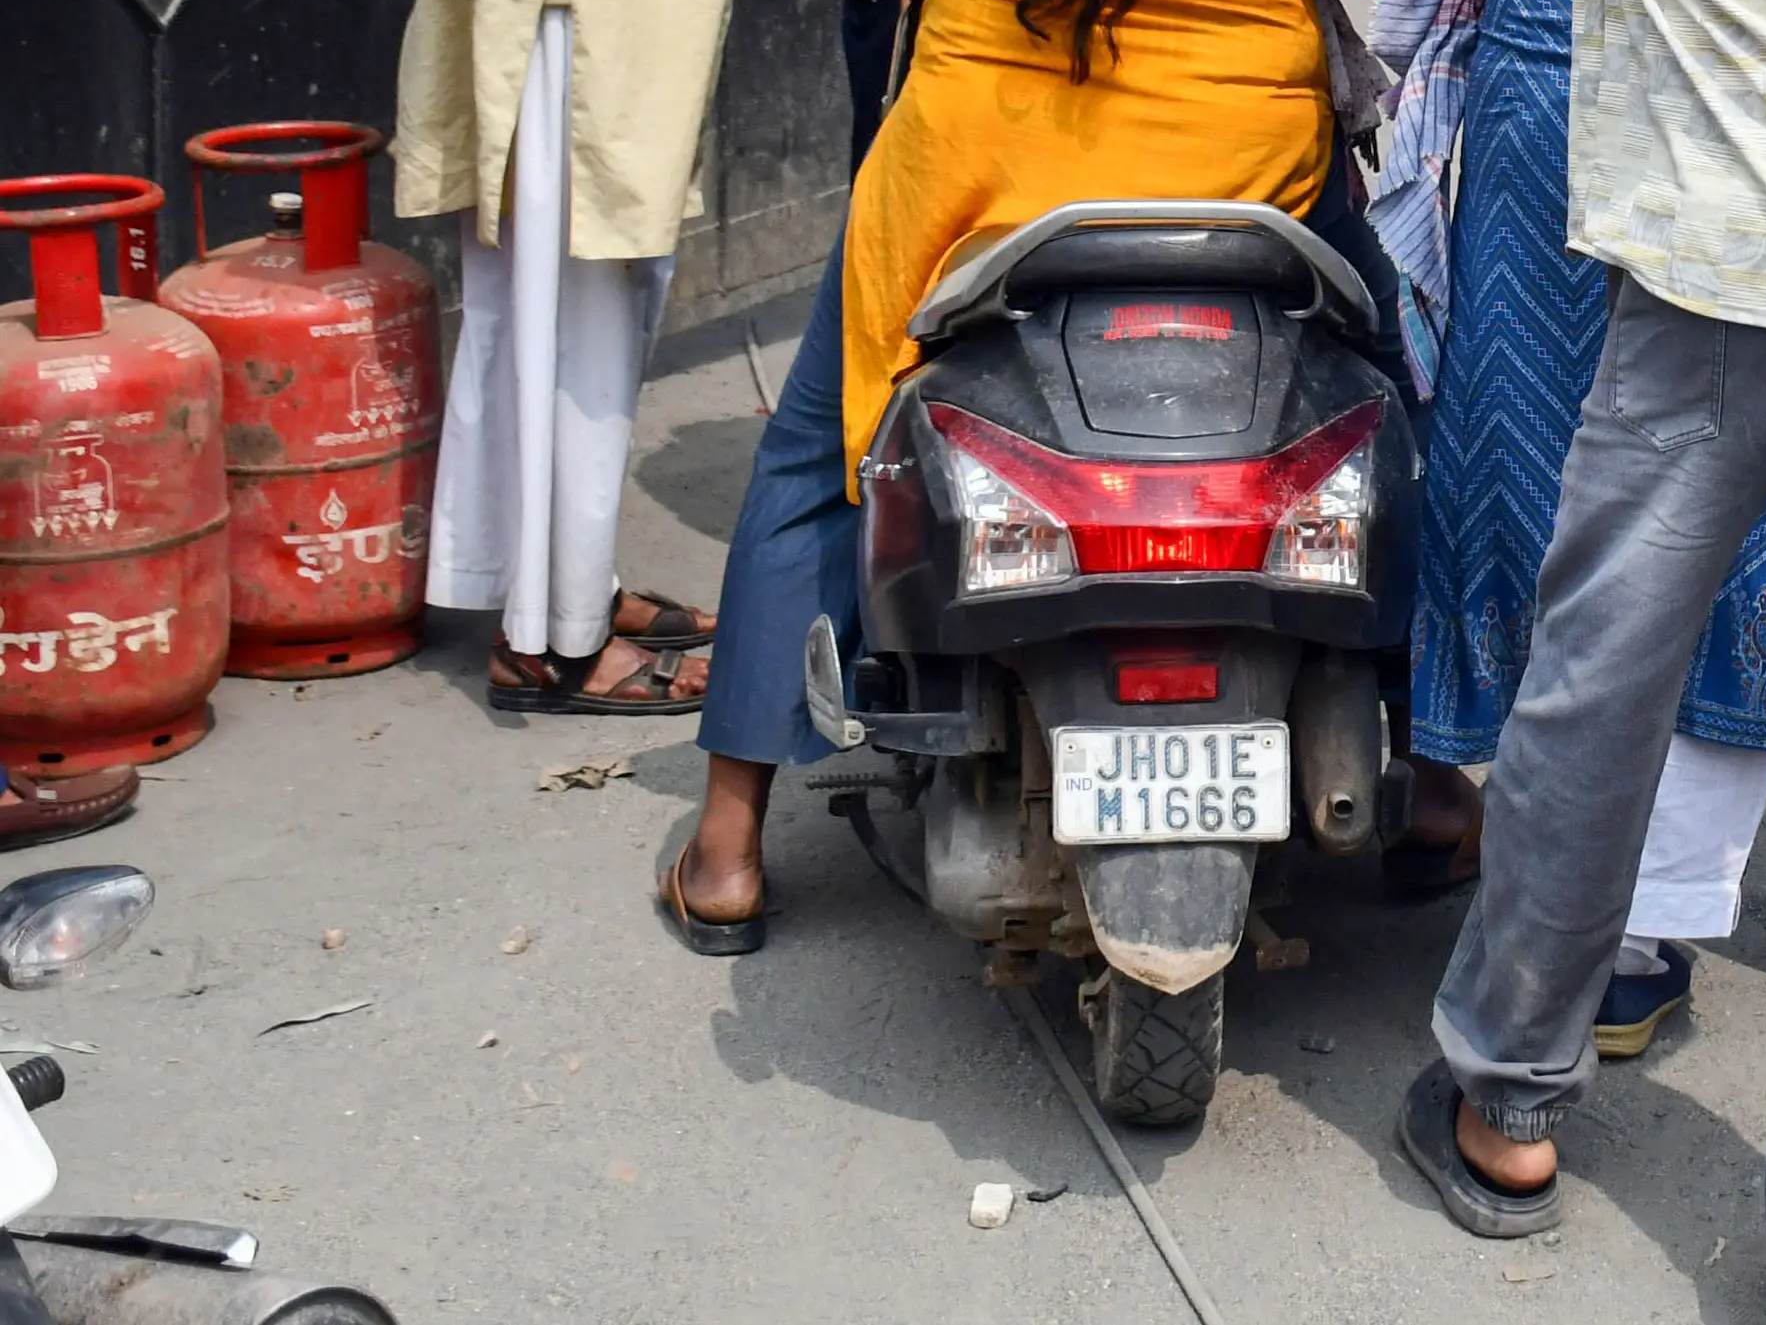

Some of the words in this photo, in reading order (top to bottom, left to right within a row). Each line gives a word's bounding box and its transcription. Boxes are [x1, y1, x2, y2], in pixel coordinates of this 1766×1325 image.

[1097, 734, 1257, 781] JH01E
[1065, 777, 1093, 792] IND
[1097, 786, 1257, 833] M1666
